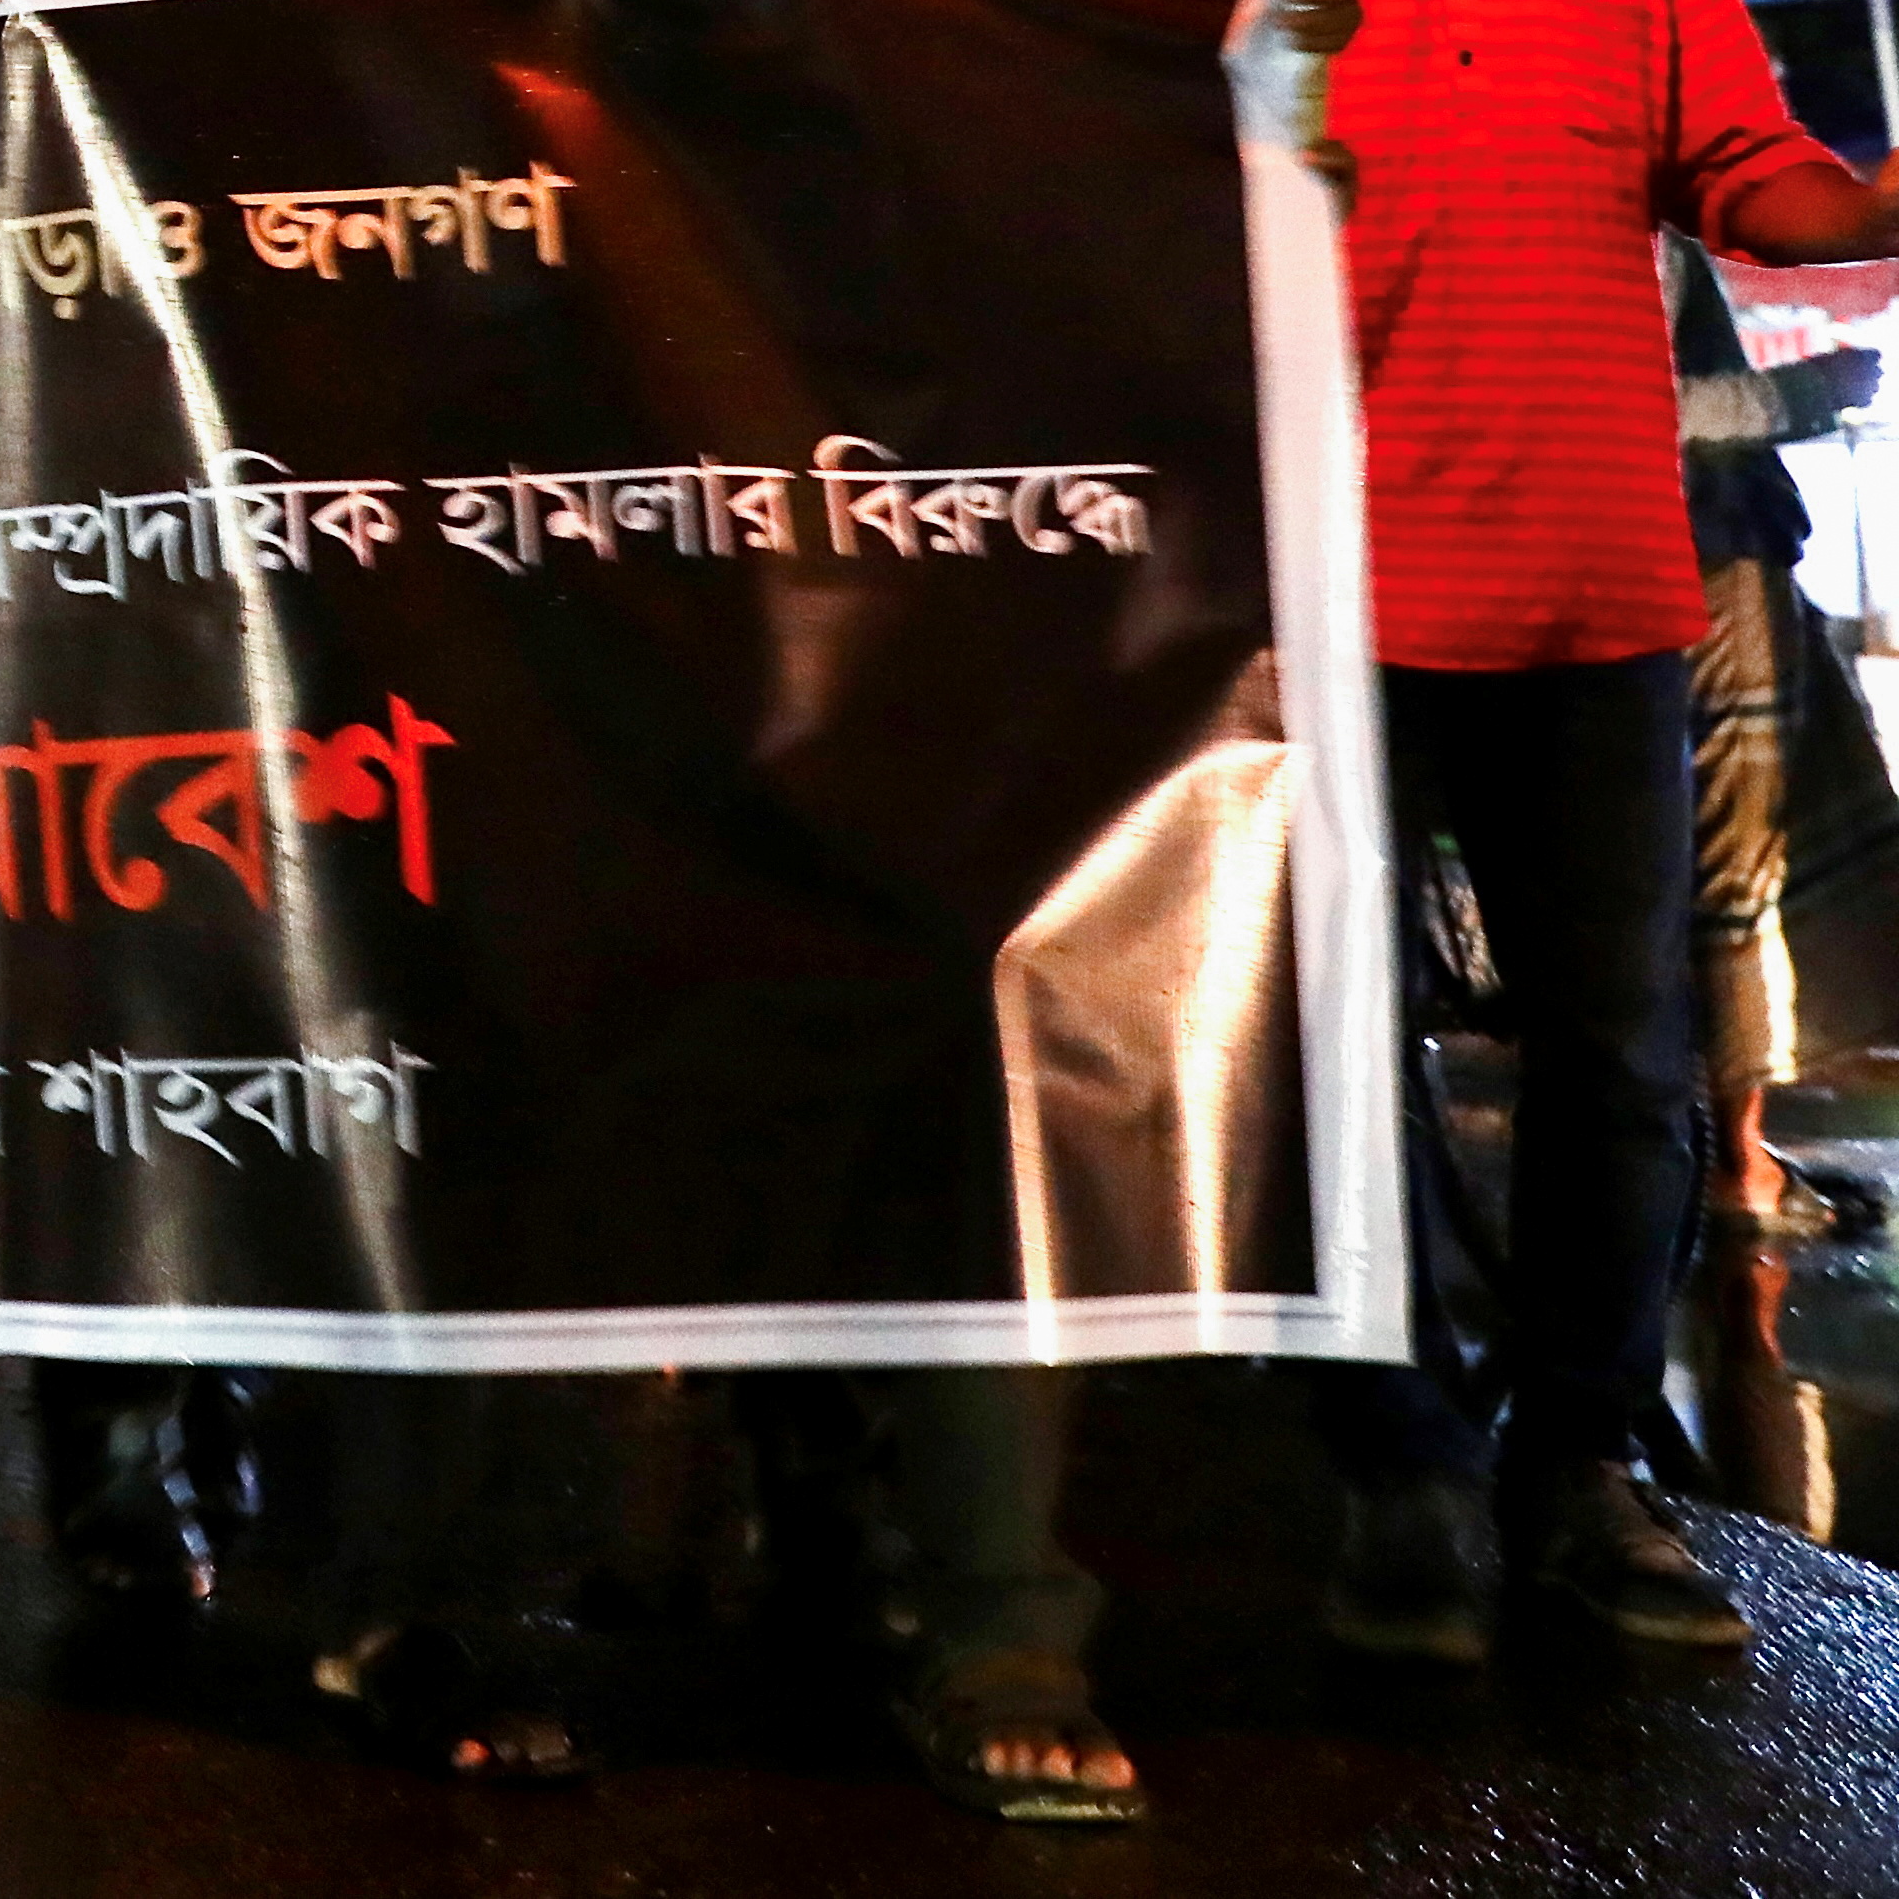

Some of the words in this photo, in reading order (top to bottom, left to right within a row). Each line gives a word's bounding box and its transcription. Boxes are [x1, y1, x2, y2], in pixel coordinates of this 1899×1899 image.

[231, 160, 576, 280] জনগণ
[421, 452, 798, 576] হামলার
[807, 433, 1155, 559] বিরুদ্ধে
[24, 1039, 439, 1171] শাহবাগ
